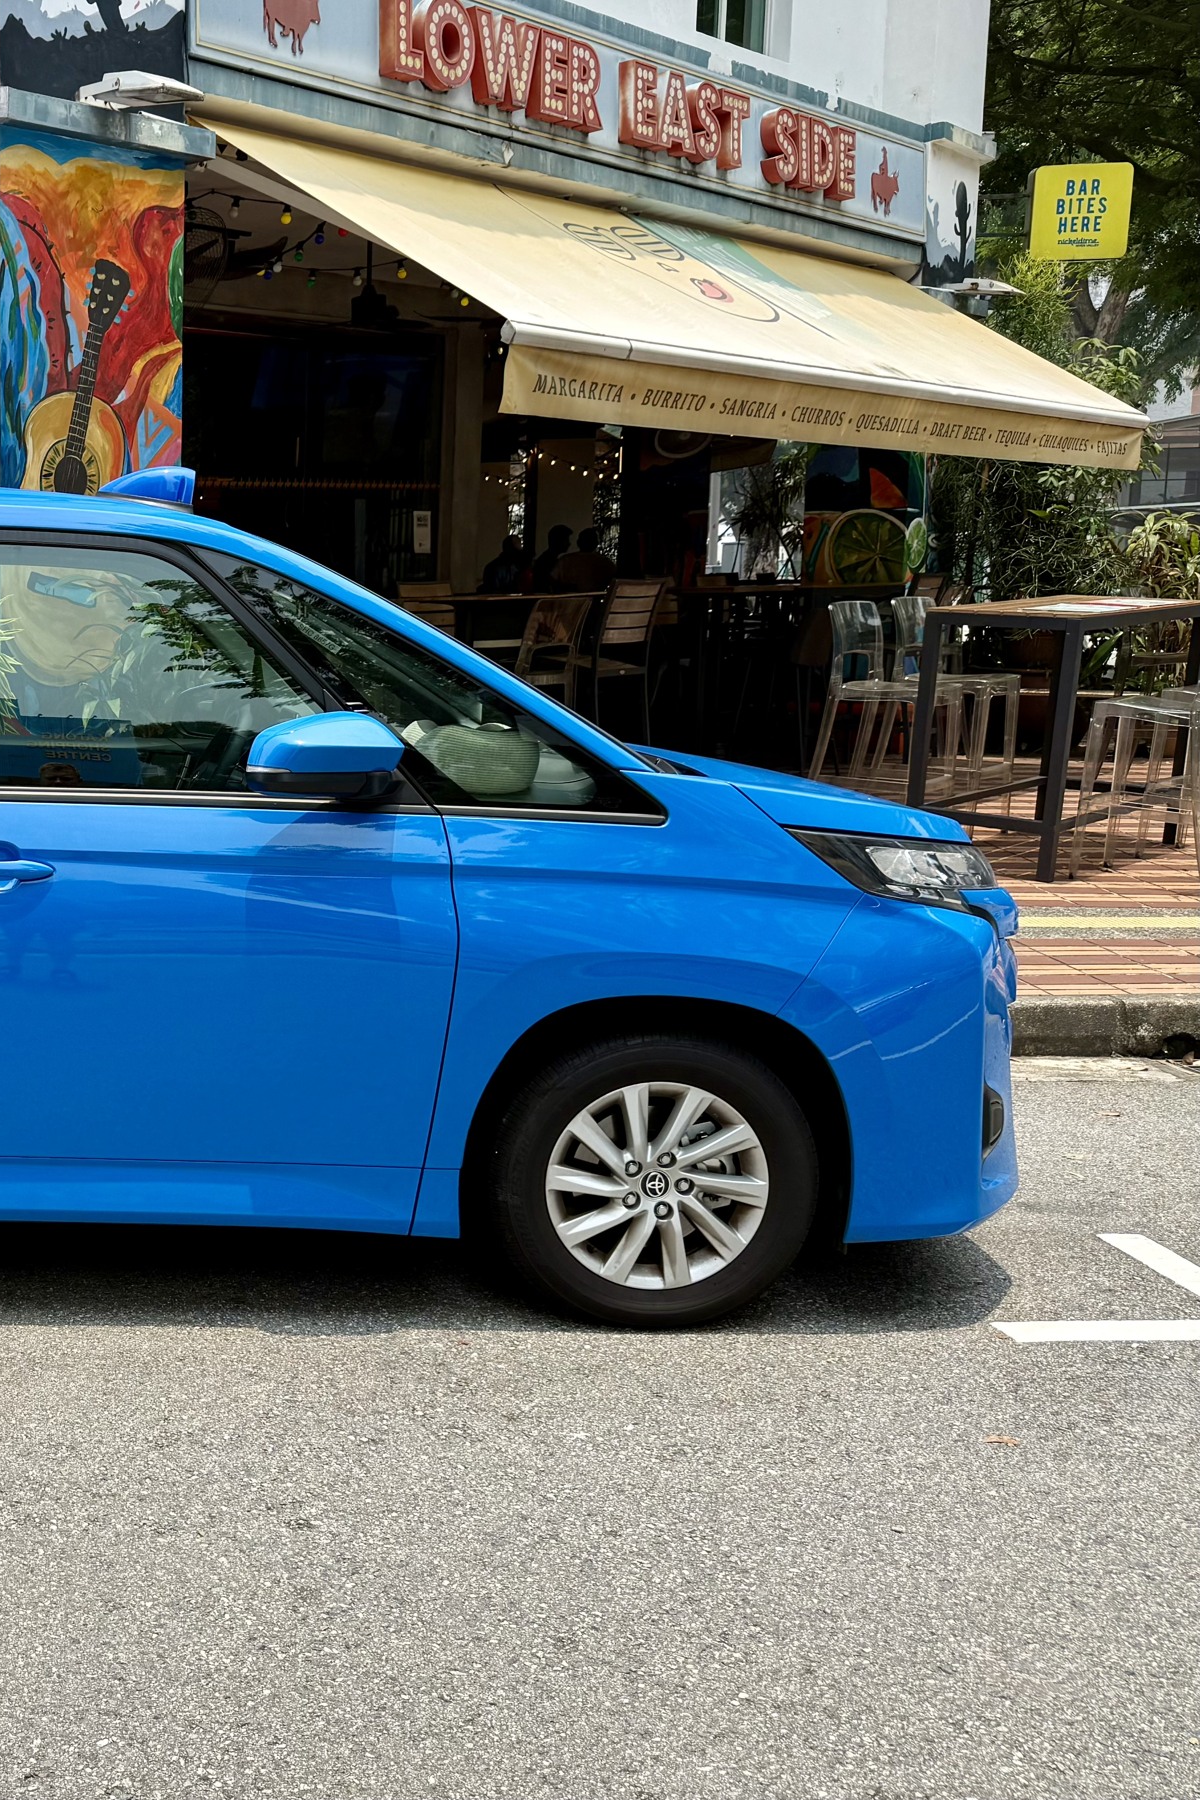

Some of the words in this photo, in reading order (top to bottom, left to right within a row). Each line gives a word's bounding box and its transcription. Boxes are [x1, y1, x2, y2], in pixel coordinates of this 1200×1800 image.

[379, 0, 604, 134] LOWER
[619, 59, 751, 170] EAST
[760, 107, 857, 201] SIDE
[1066, 178, 1101, 196] BAR
[1056, 197, 1108, 215] BITES
[1057, 215, 1102, 234] HERE
[532, 373, 625, 403] MARGARITA
[641, 388, 707, 412] BURRITO
[719, 397, 778, 420] SANGRIA
[790, 405, 846, 427] CHURROS
[855, 413, 919, 435] QUESADILLA
[929, 422, 963, 439] DRAFT
[963, 426, 987, 442] BEER
[995, 429, 1031, 447] TEQUILA
[1038, 433, 1090, 453] CHILAQUILES
[1096, 440, 1128, 456] FAJITAS
